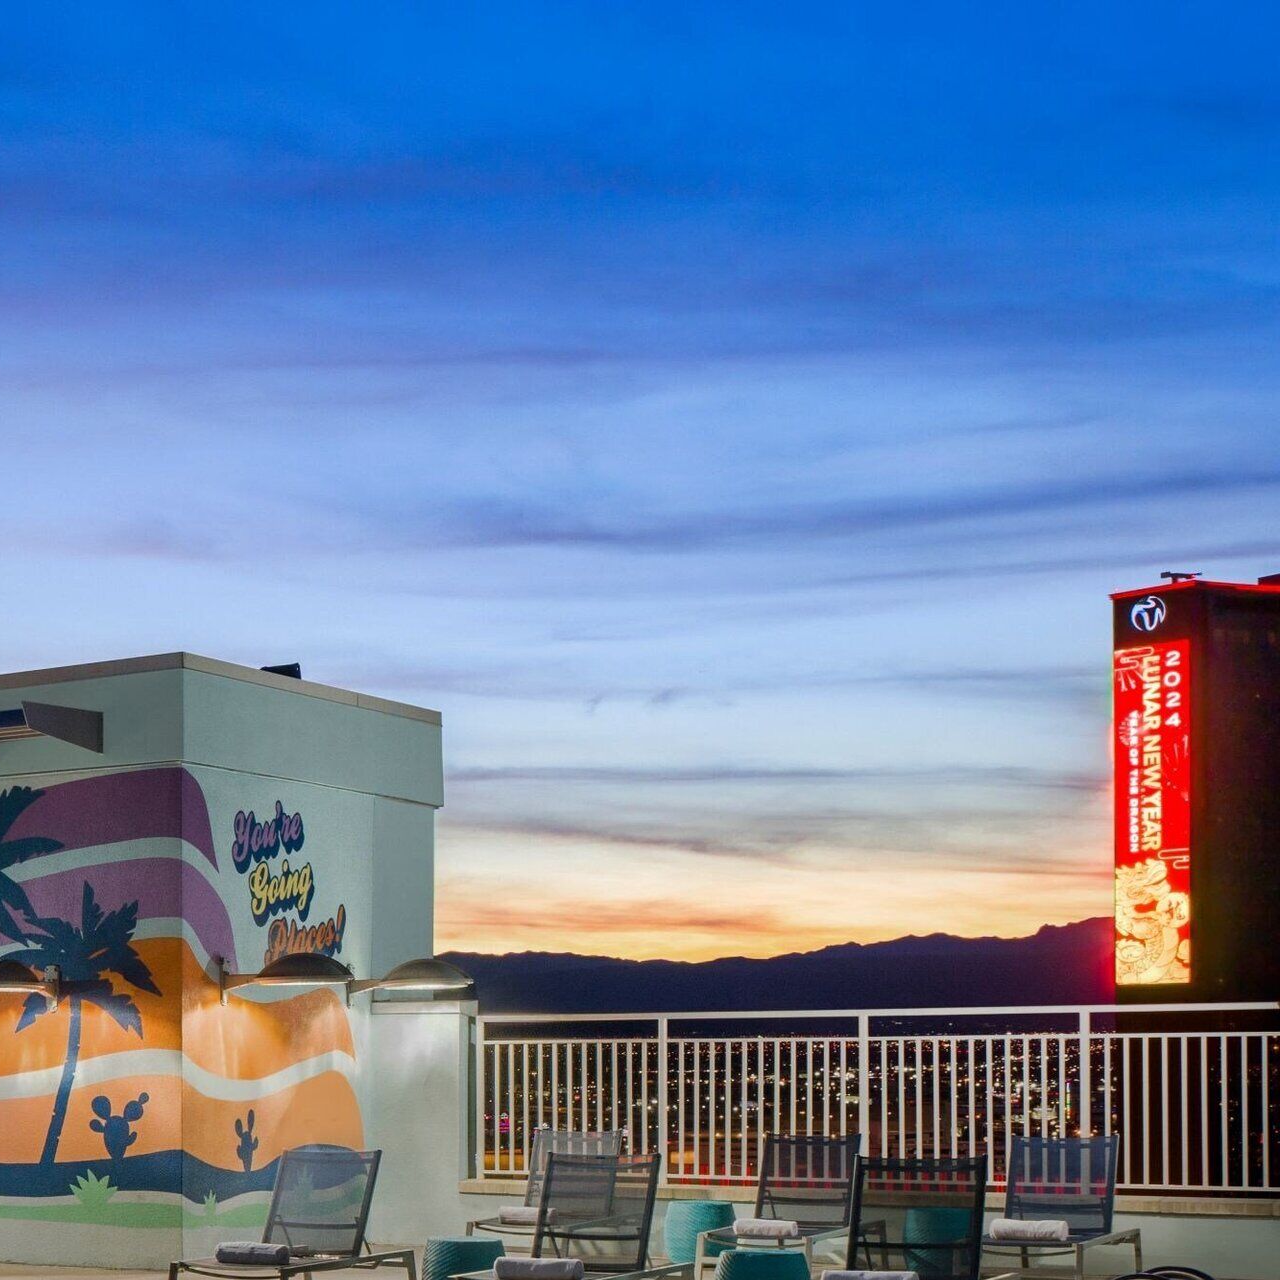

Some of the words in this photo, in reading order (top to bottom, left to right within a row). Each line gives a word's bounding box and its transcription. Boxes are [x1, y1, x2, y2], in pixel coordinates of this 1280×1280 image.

[1142, 655, 1161, 729] LUNAR
[1164, 650, 1181, 727] 2024
[1129, 748, 1139, 766] OF
[1129, 769, 1139, 794] THE
[1142, 734, 1162, 788] NEW
[232, 800, 304, 874] You're
[1129, 798, 1139, 853] DRAGON
[1141, 789, 1162, 851] YEAR
[249, 859, 314, 927] Going
[264, 904, 346, 967] Places!
